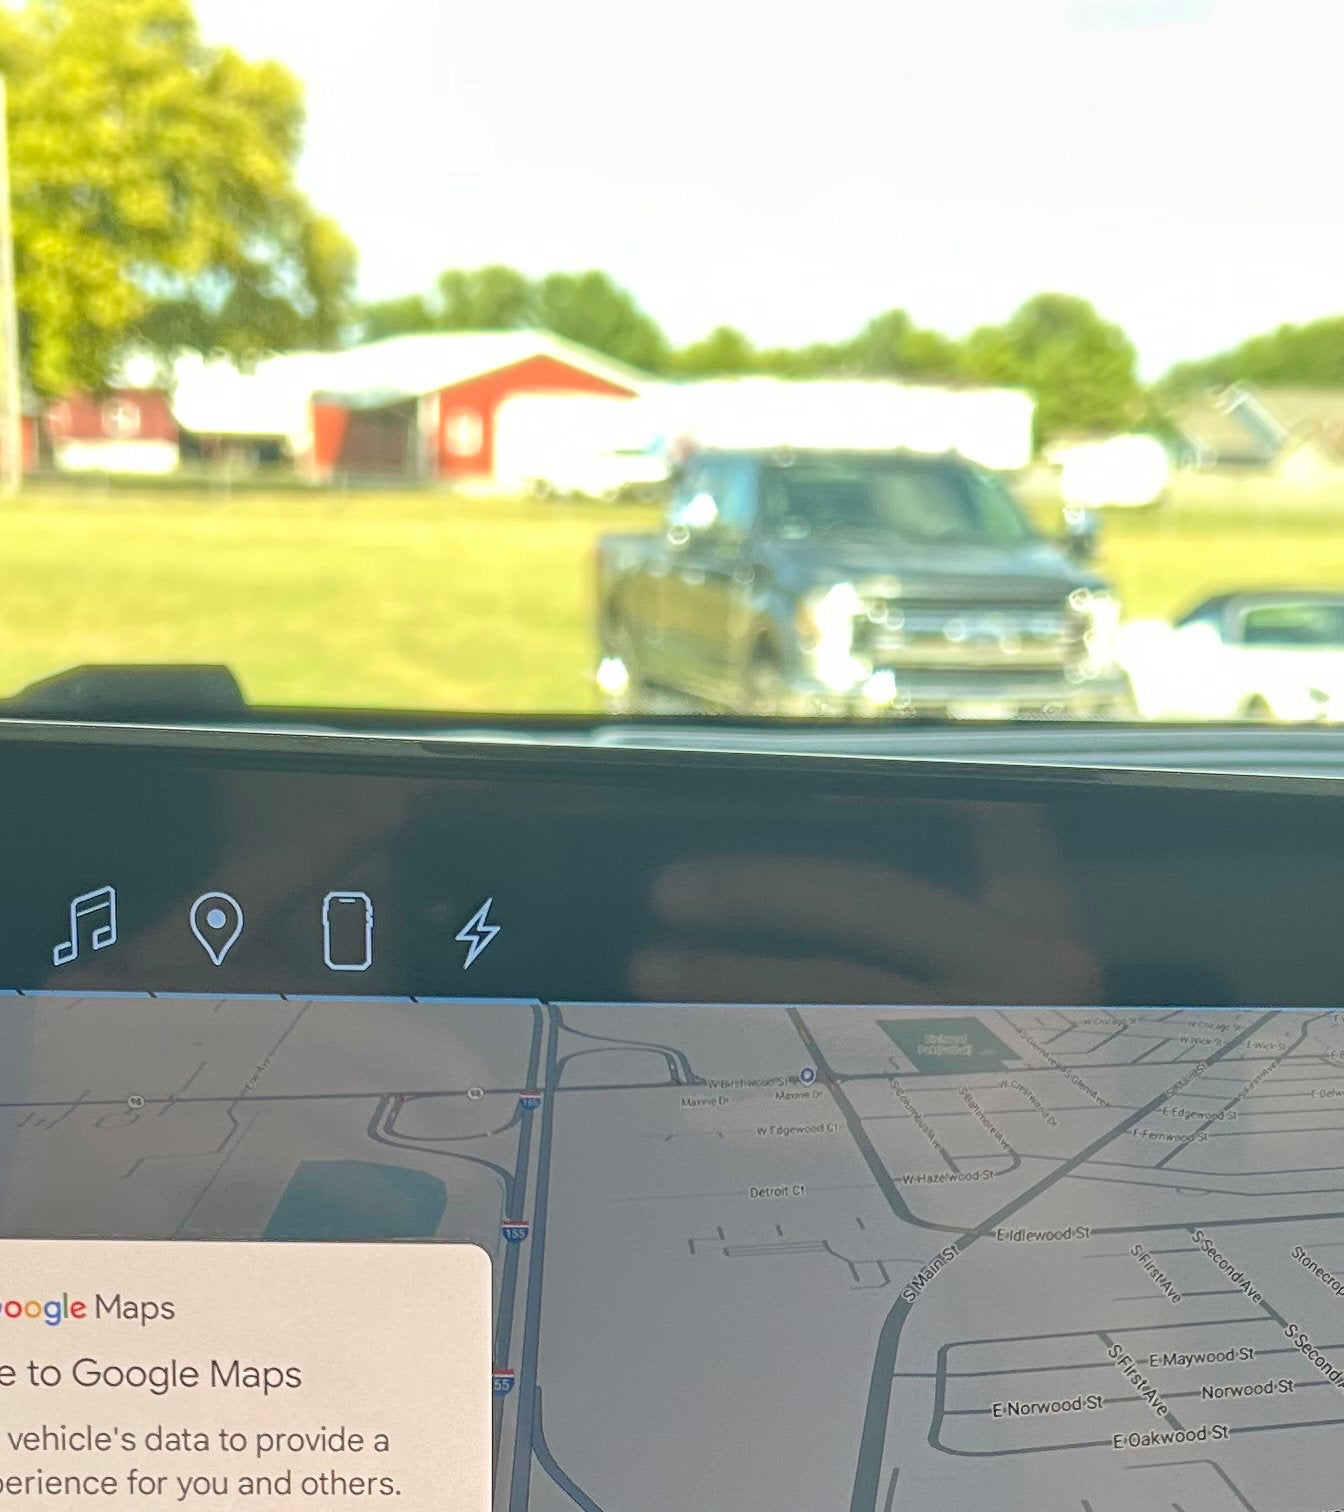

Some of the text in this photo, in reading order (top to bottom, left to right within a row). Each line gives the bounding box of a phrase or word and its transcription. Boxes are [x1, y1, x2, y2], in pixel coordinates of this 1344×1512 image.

[996, 1226, 1090, 1241] E Idlewood St
[903, 1245, 960, 1302] S Main St
[1130, 1244, 1182, 1304] S First Ave
[1192, 1230, 1262, 1303] S Second Ave
[95, 1293, 177, 1329] Maps
[1149, 1347, 1255, 1368] E Maywood St
[1284, 1323, 1298, 1338] S
[1294, 1334, 1343, 1382] Second
[26, 1361, 64, 1389] to
[72, 1358, 202, 1398] Google
[211, 1360, 304, 1398] Maps
[493, 1379, 510, 1391] 55
[1108, 1344, 1168, 1416] S First Ave
[1201, 1379, 1294, 1399] Norwood St
[993, 1395, 1103, 1418] E Norwood St
[8, 1425, 137, 1453] vehicle's
[145, 1426, 211, 1453] data
[219, 1429, 248, 1453] to
[257, 1426, 365, 1460] provide
[375, 1434, 390, 1454] a
[1113, 1425, 1229, 1449] E Oakwood St
[127, 1469, 169, 1497] for
[177, 1477, 229, 1503] you
[239, 1470, 293, 1497] and
[302, 1470, 402, 1497] others.
